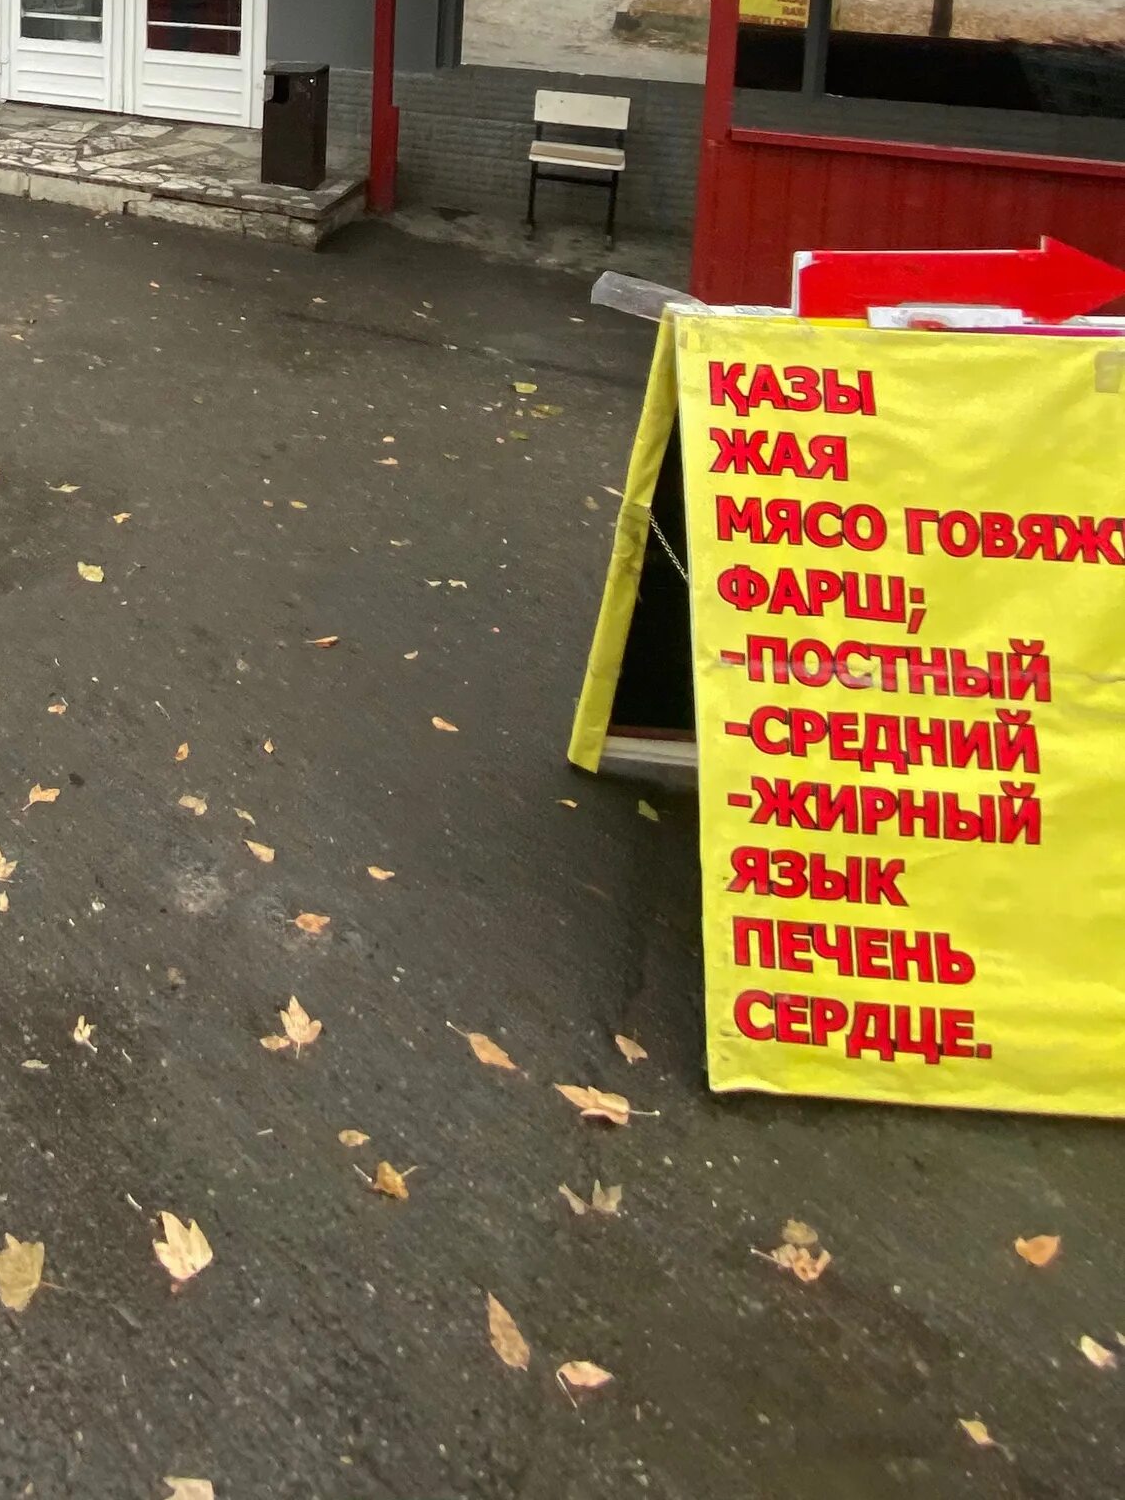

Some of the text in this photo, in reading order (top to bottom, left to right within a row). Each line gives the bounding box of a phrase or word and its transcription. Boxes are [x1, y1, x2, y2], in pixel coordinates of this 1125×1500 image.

[708, 361, 876, 417] ҚАЗЫ
[709, 427, 848, 481] ЖАЯ
[715, 495, 887, 551] МЯСО
[717, 564, 925, 634] ФАРШ;
[721, 635, 1051, 703] -ПОСТНЫЙ
[725, 705, 1041, 775] -СРЕДНИЙ
[727, 776, 1041, 845] -ЖИРНЫЙ
[729, 846, 906, 906] ЯЗЫК
[733, 916, 975, 985] ПЕЧЕНЬ
[734, 990, 992, 1065] СЕРДЦЕ.
